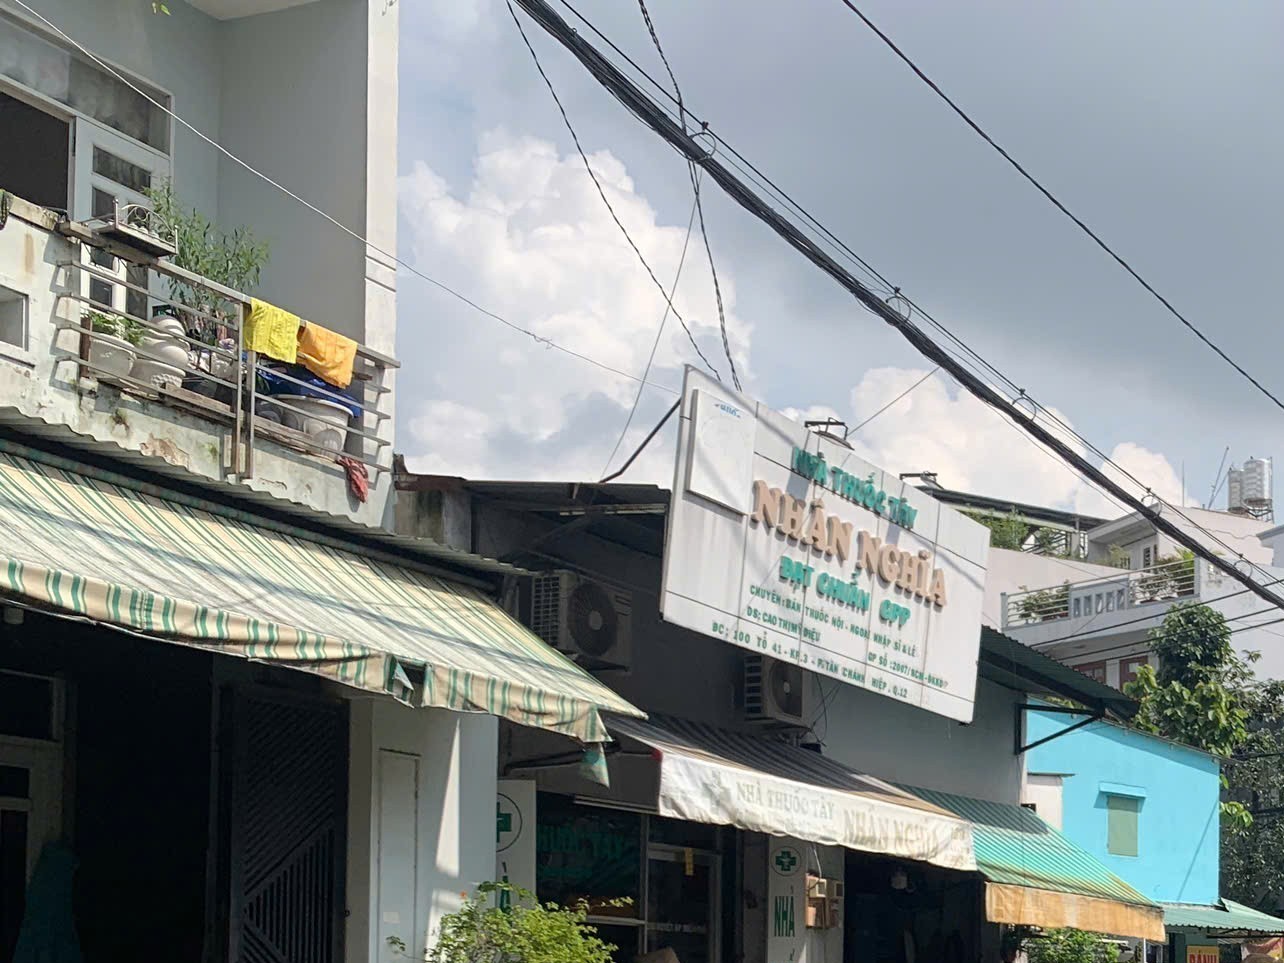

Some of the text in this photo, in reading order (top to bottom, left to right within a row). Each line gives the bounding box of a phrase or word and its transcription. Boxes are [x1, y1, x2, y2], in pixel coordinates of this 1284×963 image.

[791, 446, 827, 485] NHÀ
[751, 480, 946, 607] NHÂN NGHĨA
[879, 599, 911, 625] GPP
[733, 630, 751, 644] 100
[771, 644, 782, 655] 41
[774, 885, 795, 937] NHÀ
